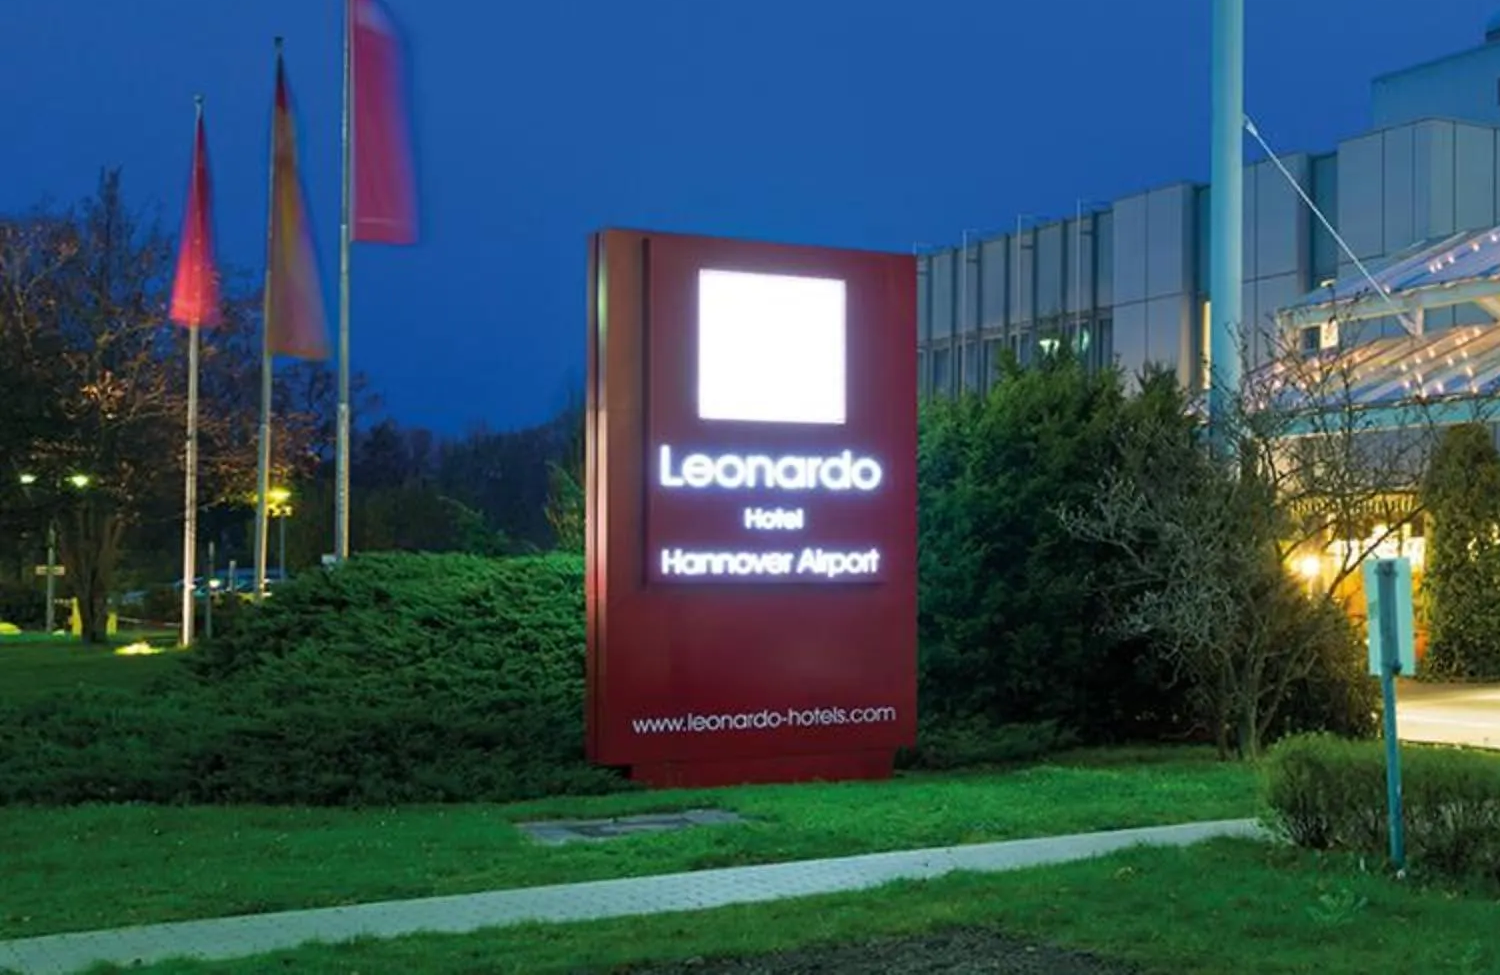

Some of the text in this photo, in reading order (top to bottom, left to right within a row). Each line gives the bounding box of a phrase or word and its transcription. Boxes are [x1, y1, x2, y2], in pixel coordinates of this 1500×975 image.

[659, 444, 883, 490] Leonardo
[744, 507, 804, 529] Hotel
[661, 547, 880, 577] Hannover Airport
[632, 706, 897, 734] www.leonardo-hotels.com
